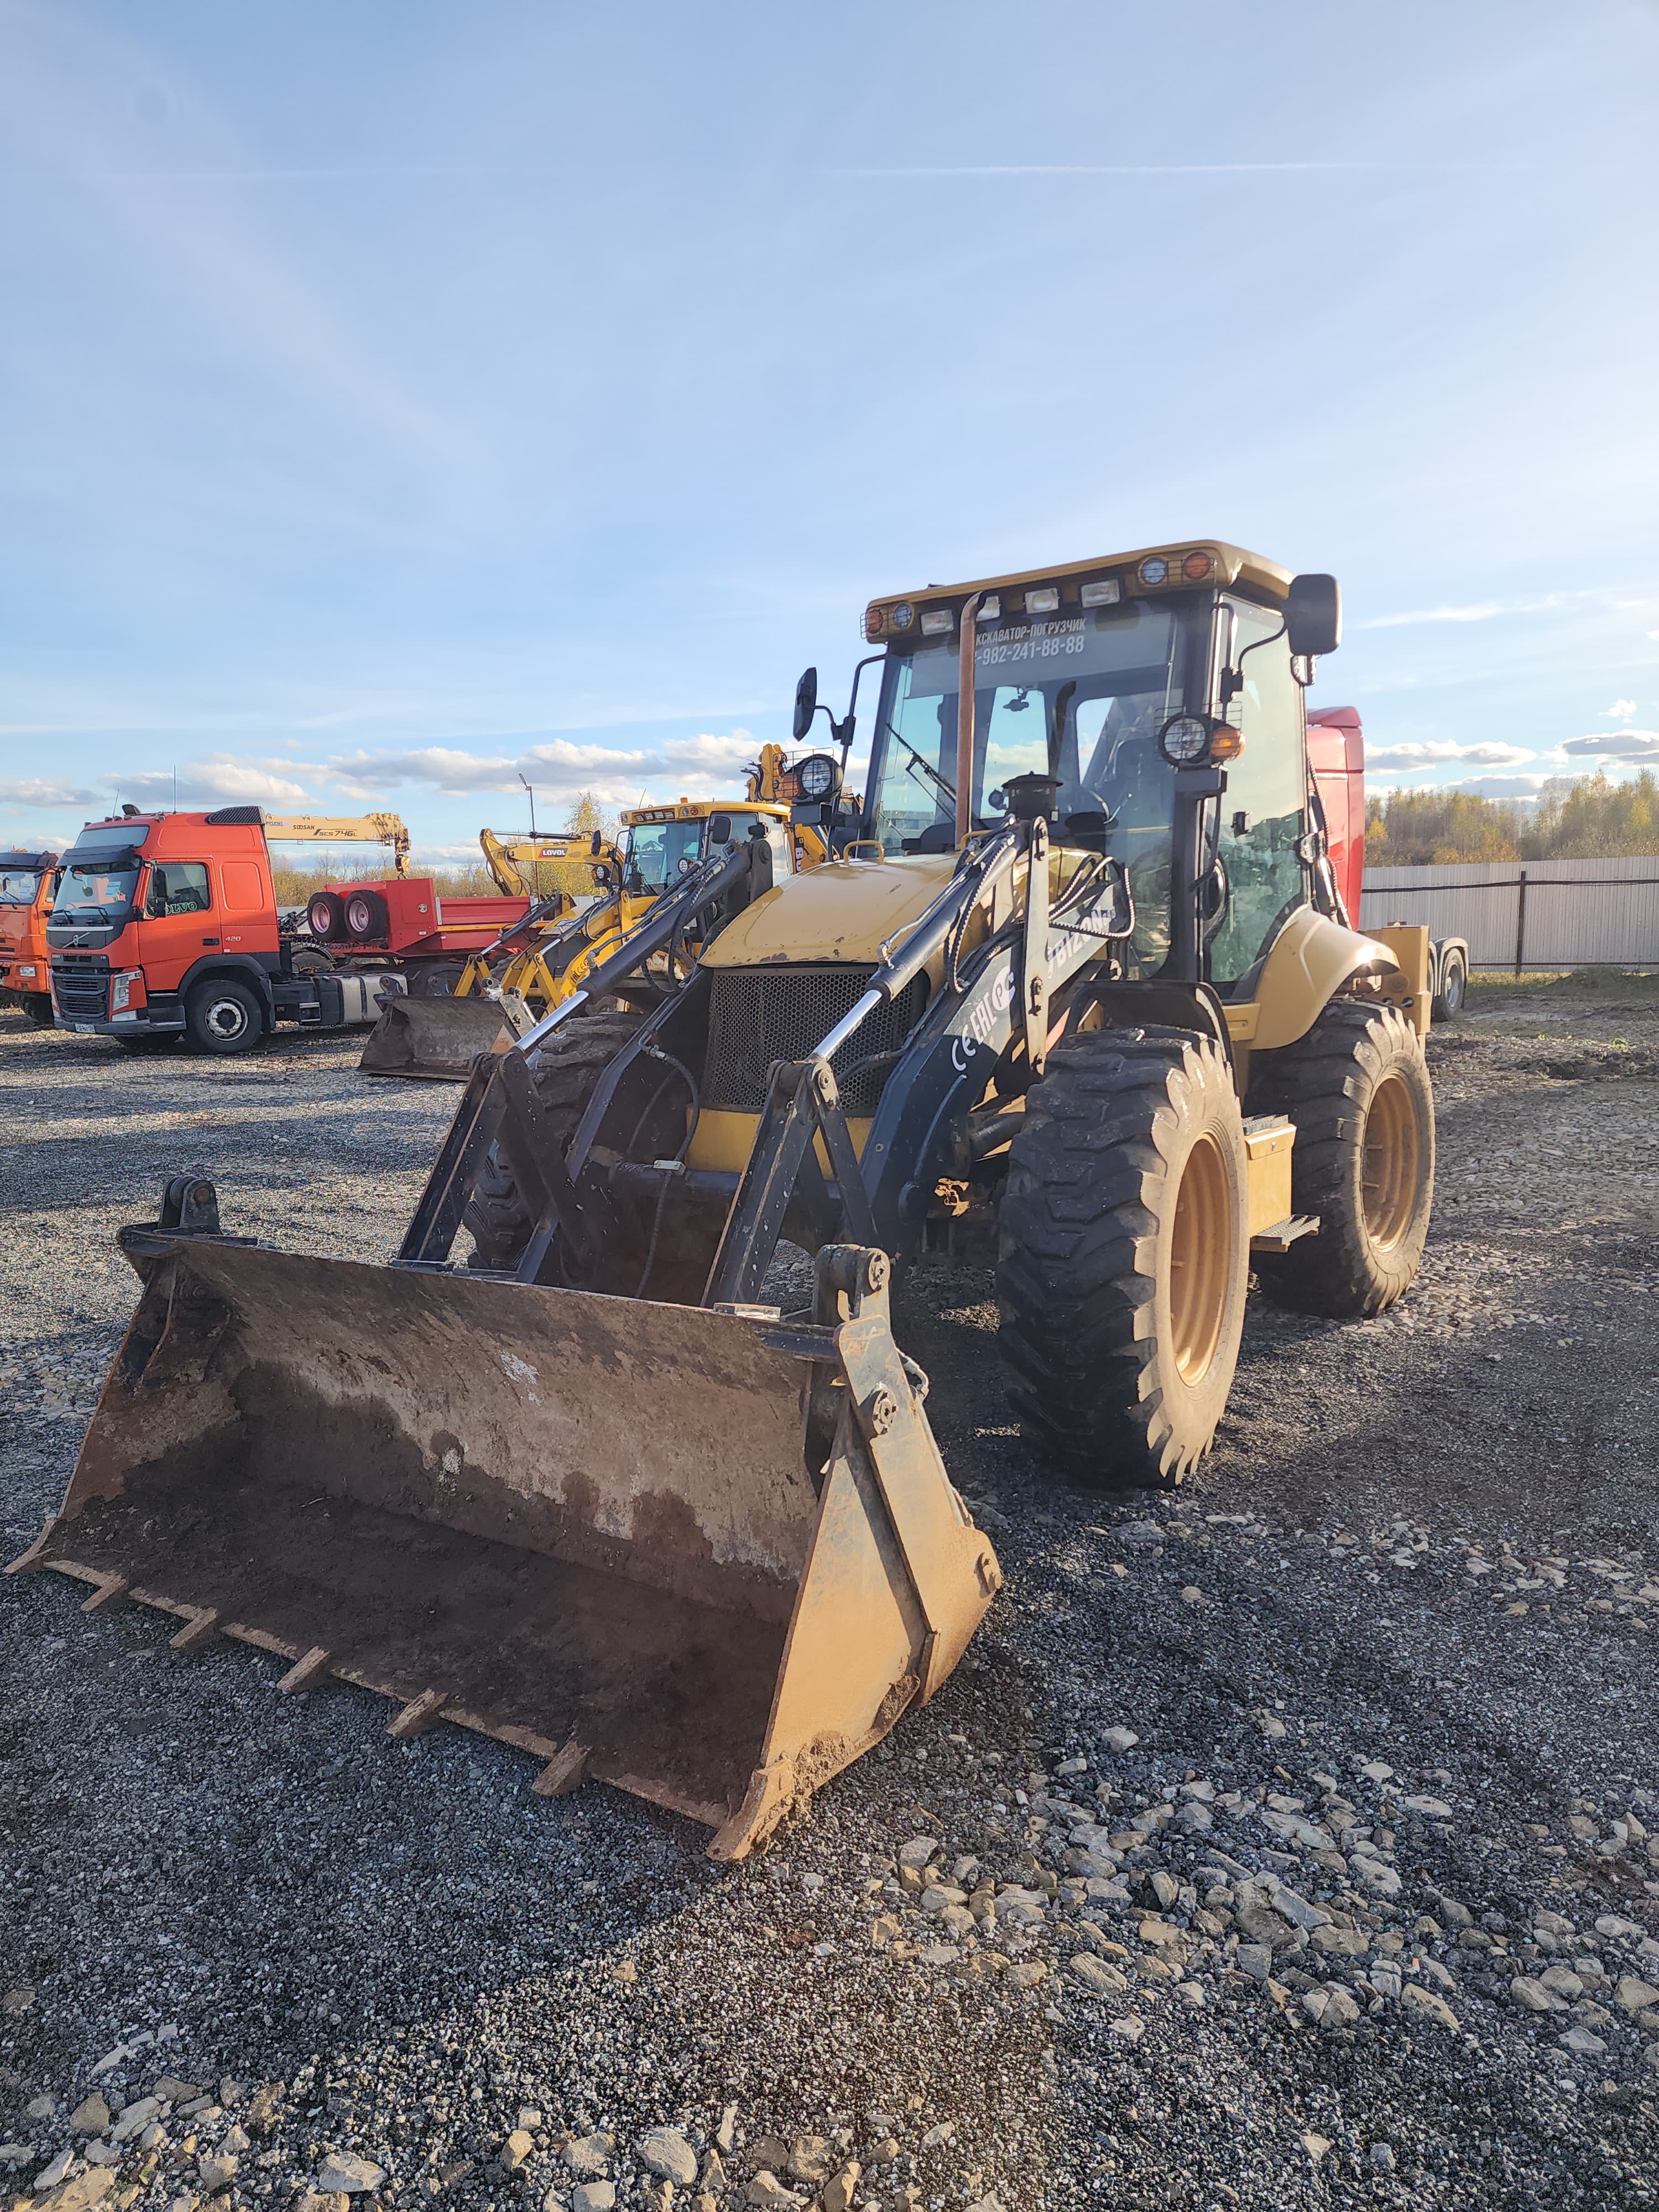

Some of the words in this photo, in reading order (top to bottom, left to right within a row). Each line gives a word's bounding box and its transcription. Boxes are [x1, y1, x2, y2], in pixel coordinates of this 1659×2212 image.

[976, 618, 1087, 646] КСКАВАТОР-ПОГРУЗЧИК
[975, 635, 1084, 665] -982-241-88-88
[165, 901, 197, 915] OLVO
